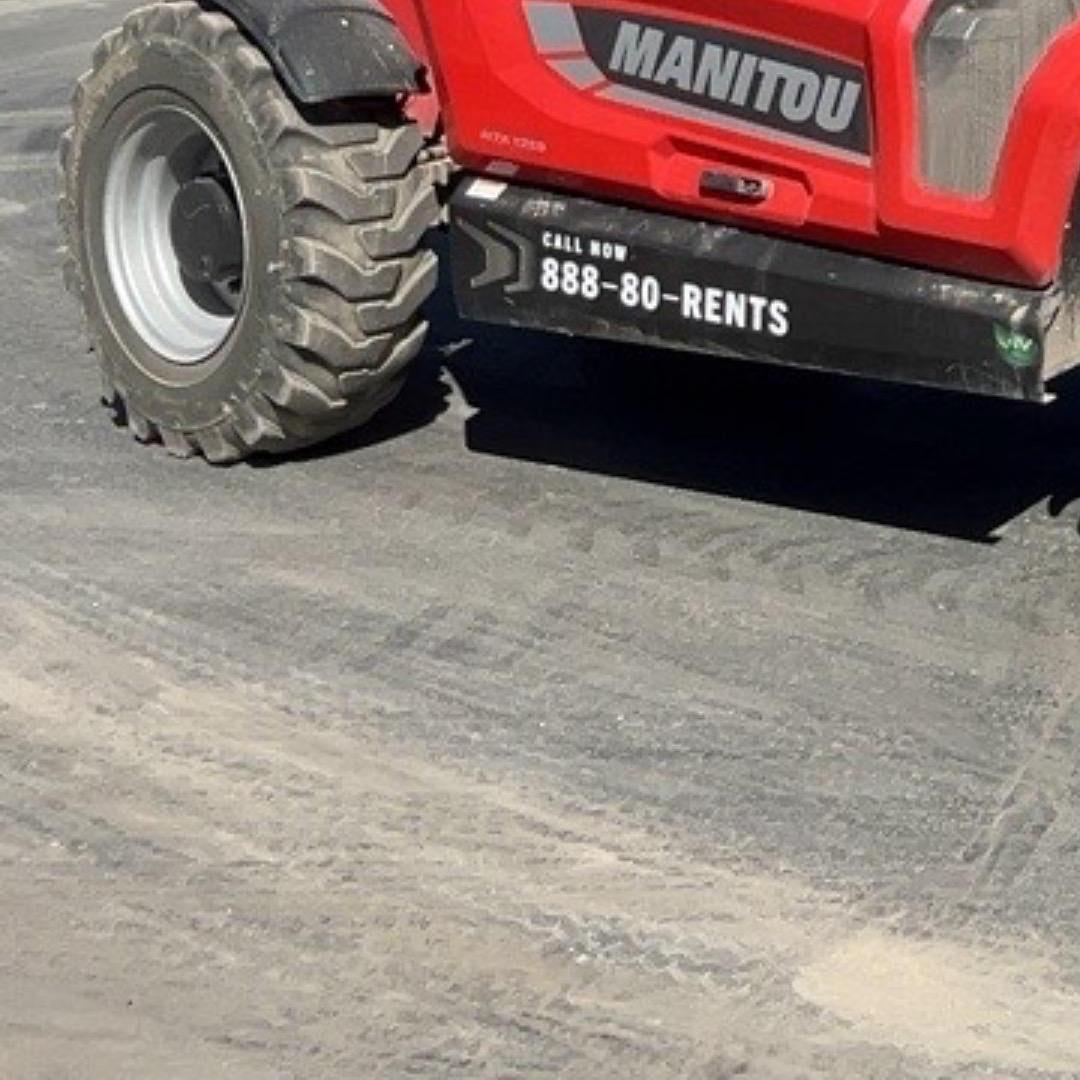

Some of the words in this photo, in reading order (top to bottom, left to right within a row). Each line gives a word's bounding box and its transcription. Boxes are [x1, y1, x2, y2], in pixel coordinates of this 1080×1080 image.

[608, 20, 862, 133] MANITOU
[541, 230, 583, 255] CALL
[590, 239, 628, 262] NOW
[541, 257, 789, 337] 888-80-RENTS
